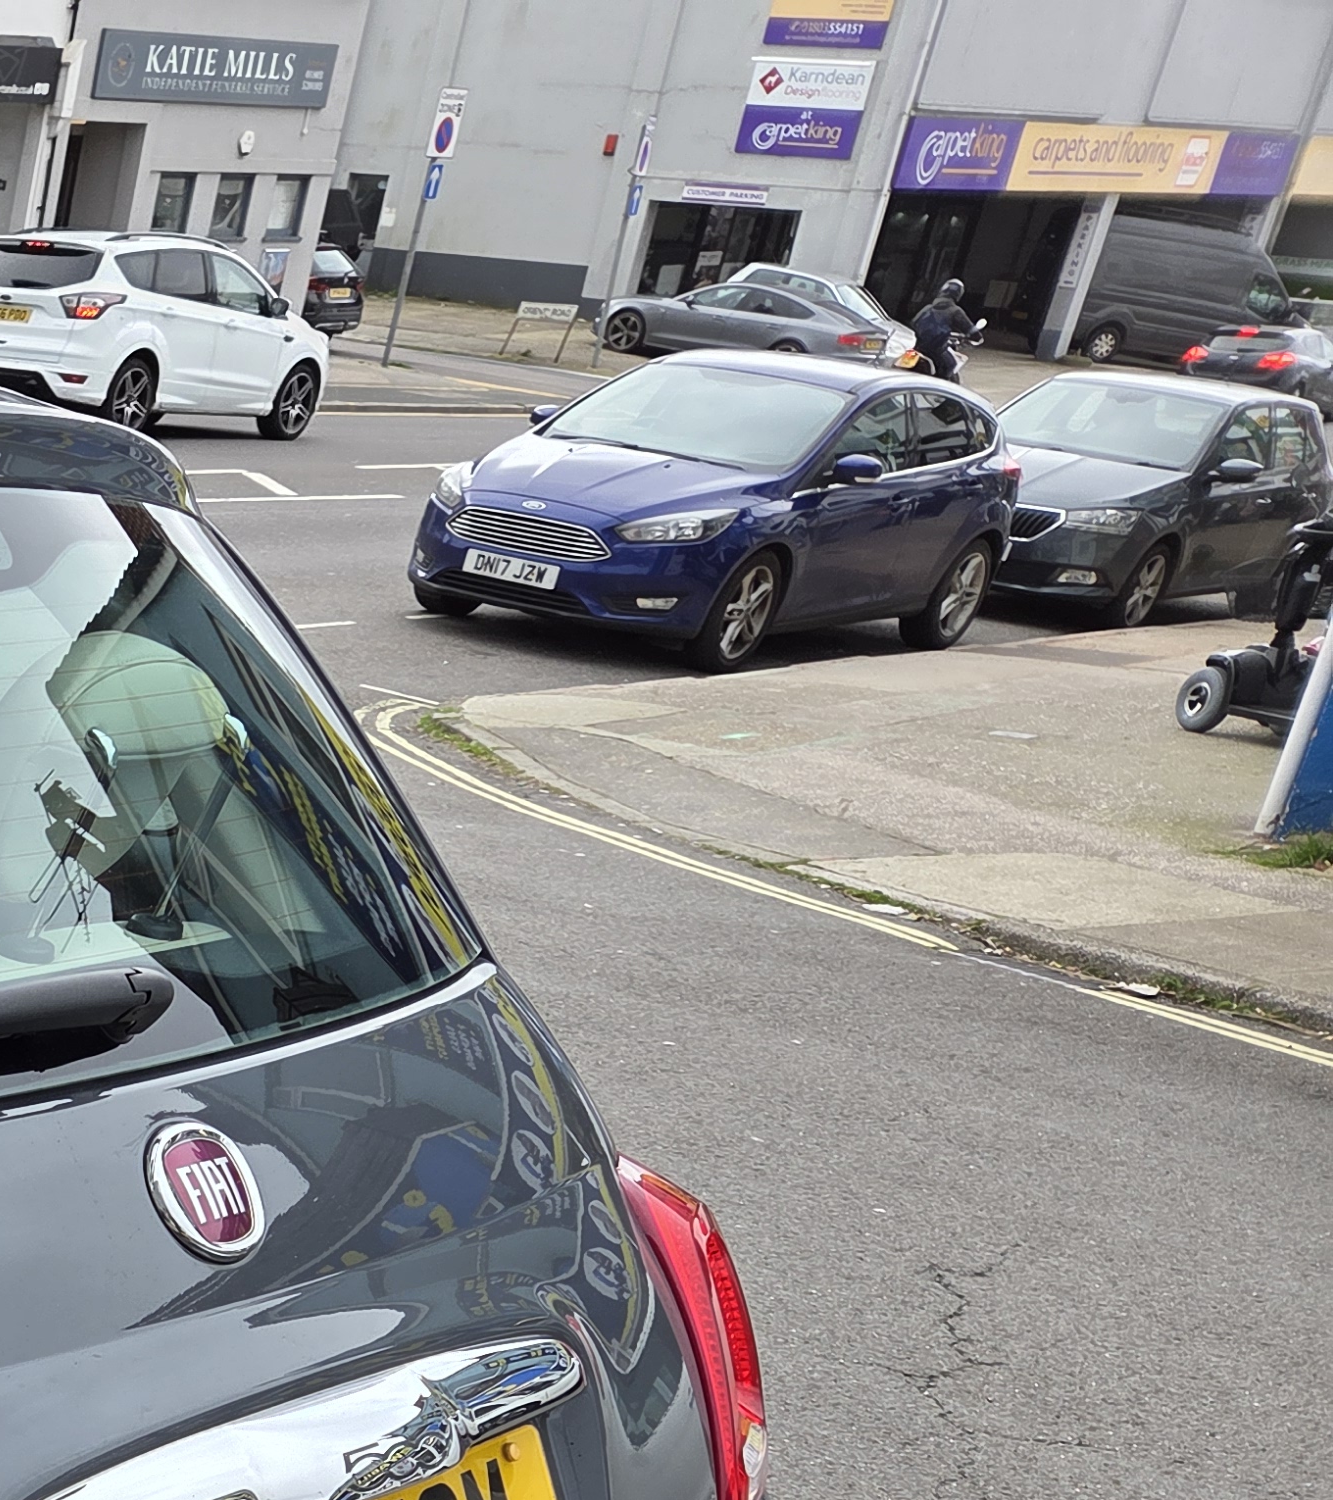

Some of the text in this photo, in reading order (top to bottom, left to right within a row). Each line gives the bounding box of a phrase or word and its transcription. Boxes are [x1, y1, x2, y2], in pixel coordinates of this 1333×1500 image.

[145, 44, 219, 76] KATIE
[223, 49, 297, 81] MILLS
[141, 76, 290, 96] INDEPENDENT FUNERAL SERVICE
[788, 66, 866, 86] Karndean
[800, 110, 813, 120] at
[1032, 131, 1174, 172] carpets and flooring
[686, 188, 765, 200] CUSTOMER PARKING
[474, 553, 548, 584] DN17 JZW
[175, 1156, 246, 1225] FIAT
